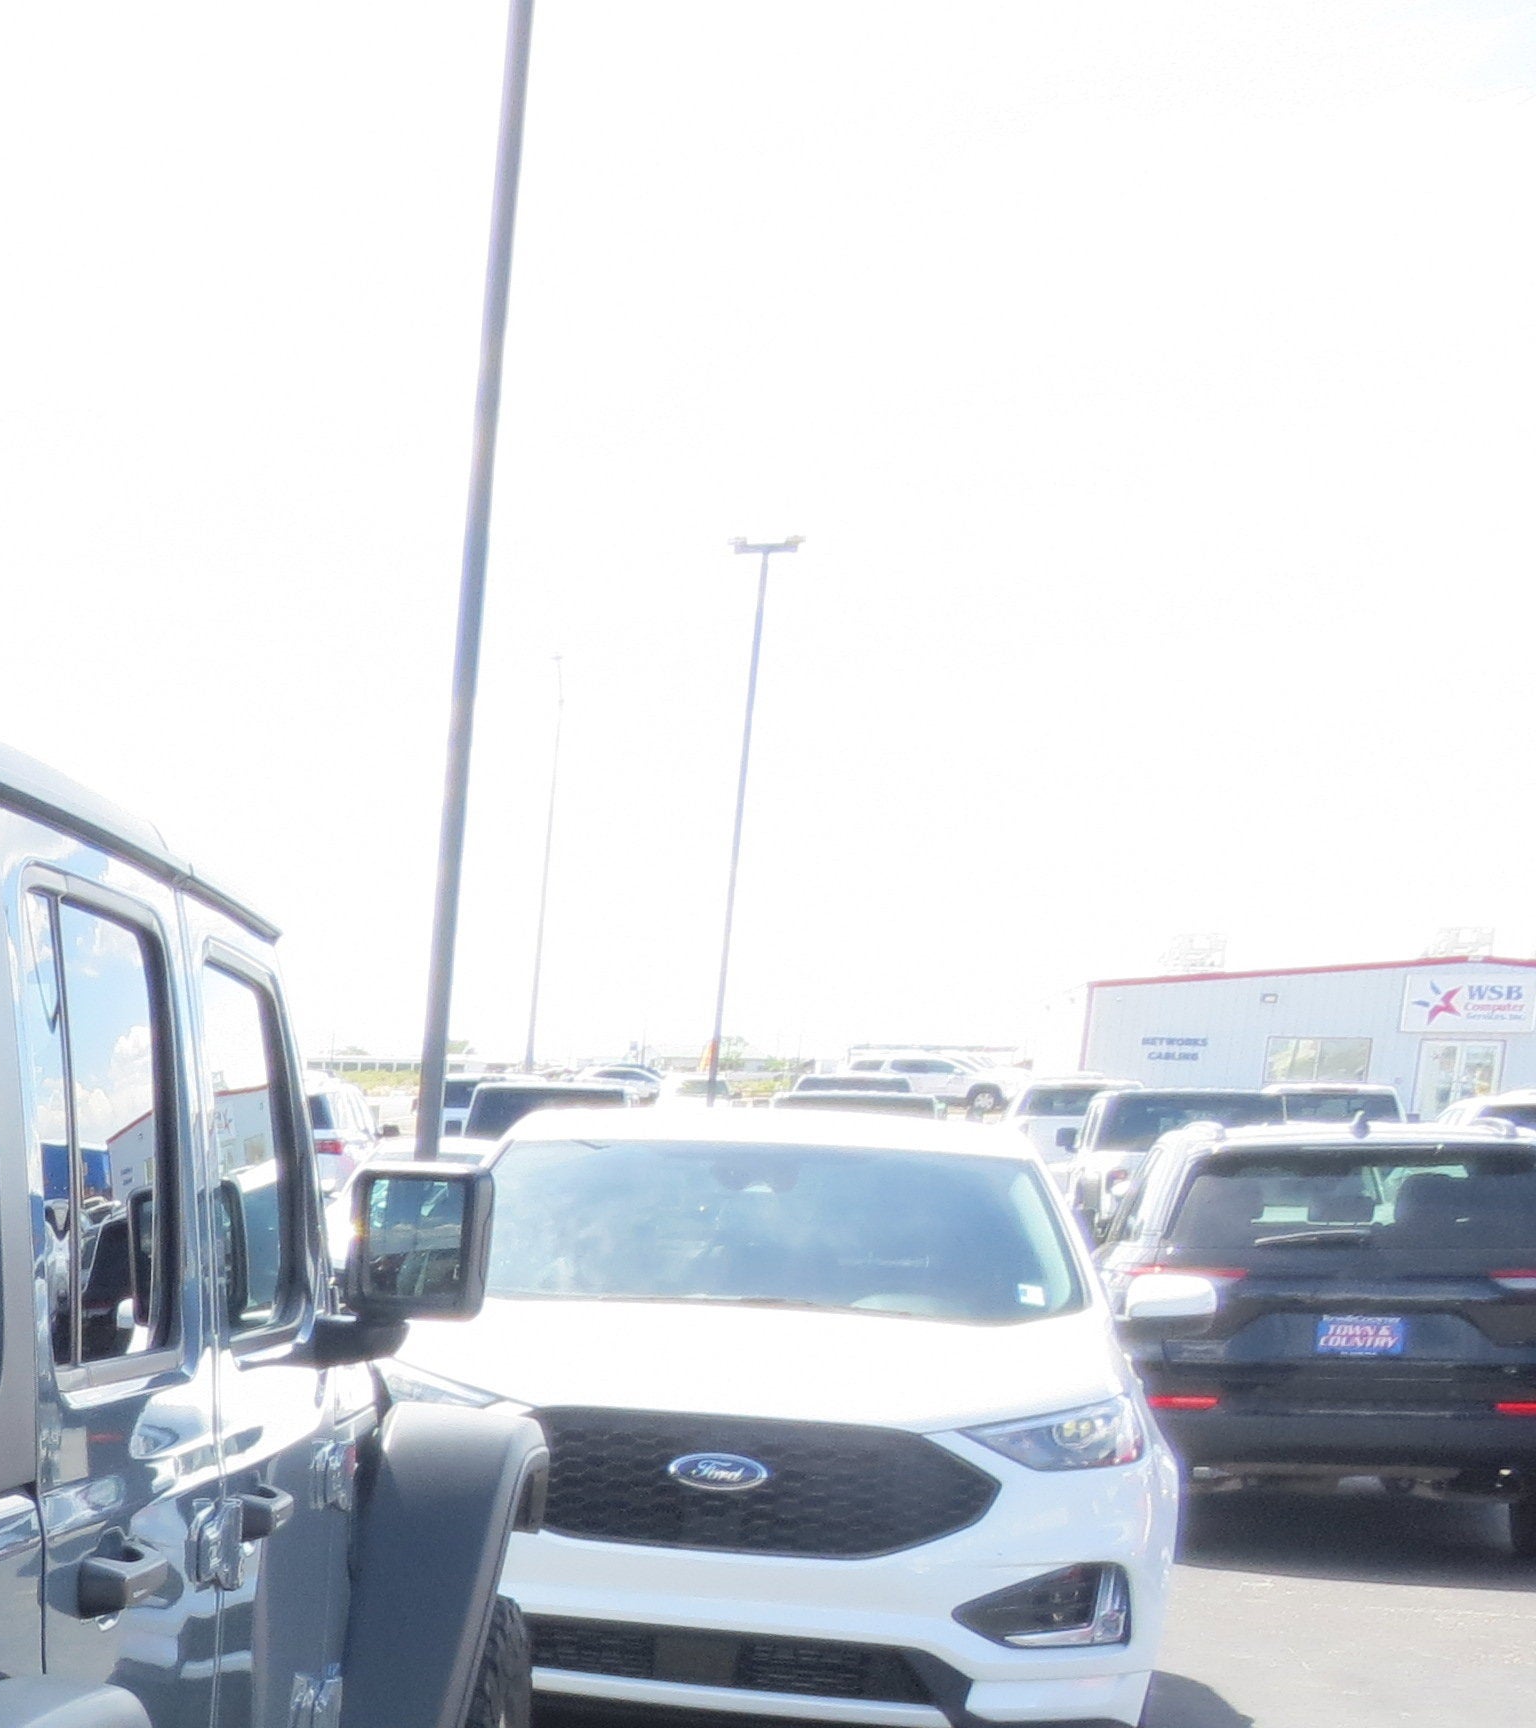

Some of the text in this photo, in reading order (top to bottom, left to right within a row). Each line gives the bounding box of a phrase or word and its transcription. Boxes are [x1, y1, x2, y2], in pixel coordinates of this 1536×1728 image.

[1467, 984, 1524, 1001] WSB
[1464, 1002, 1526, 1013] Computer
[1327, 1324, 1378, 1336] TOWN
[1319, 1334, 1399, 1350] COUNTRY
